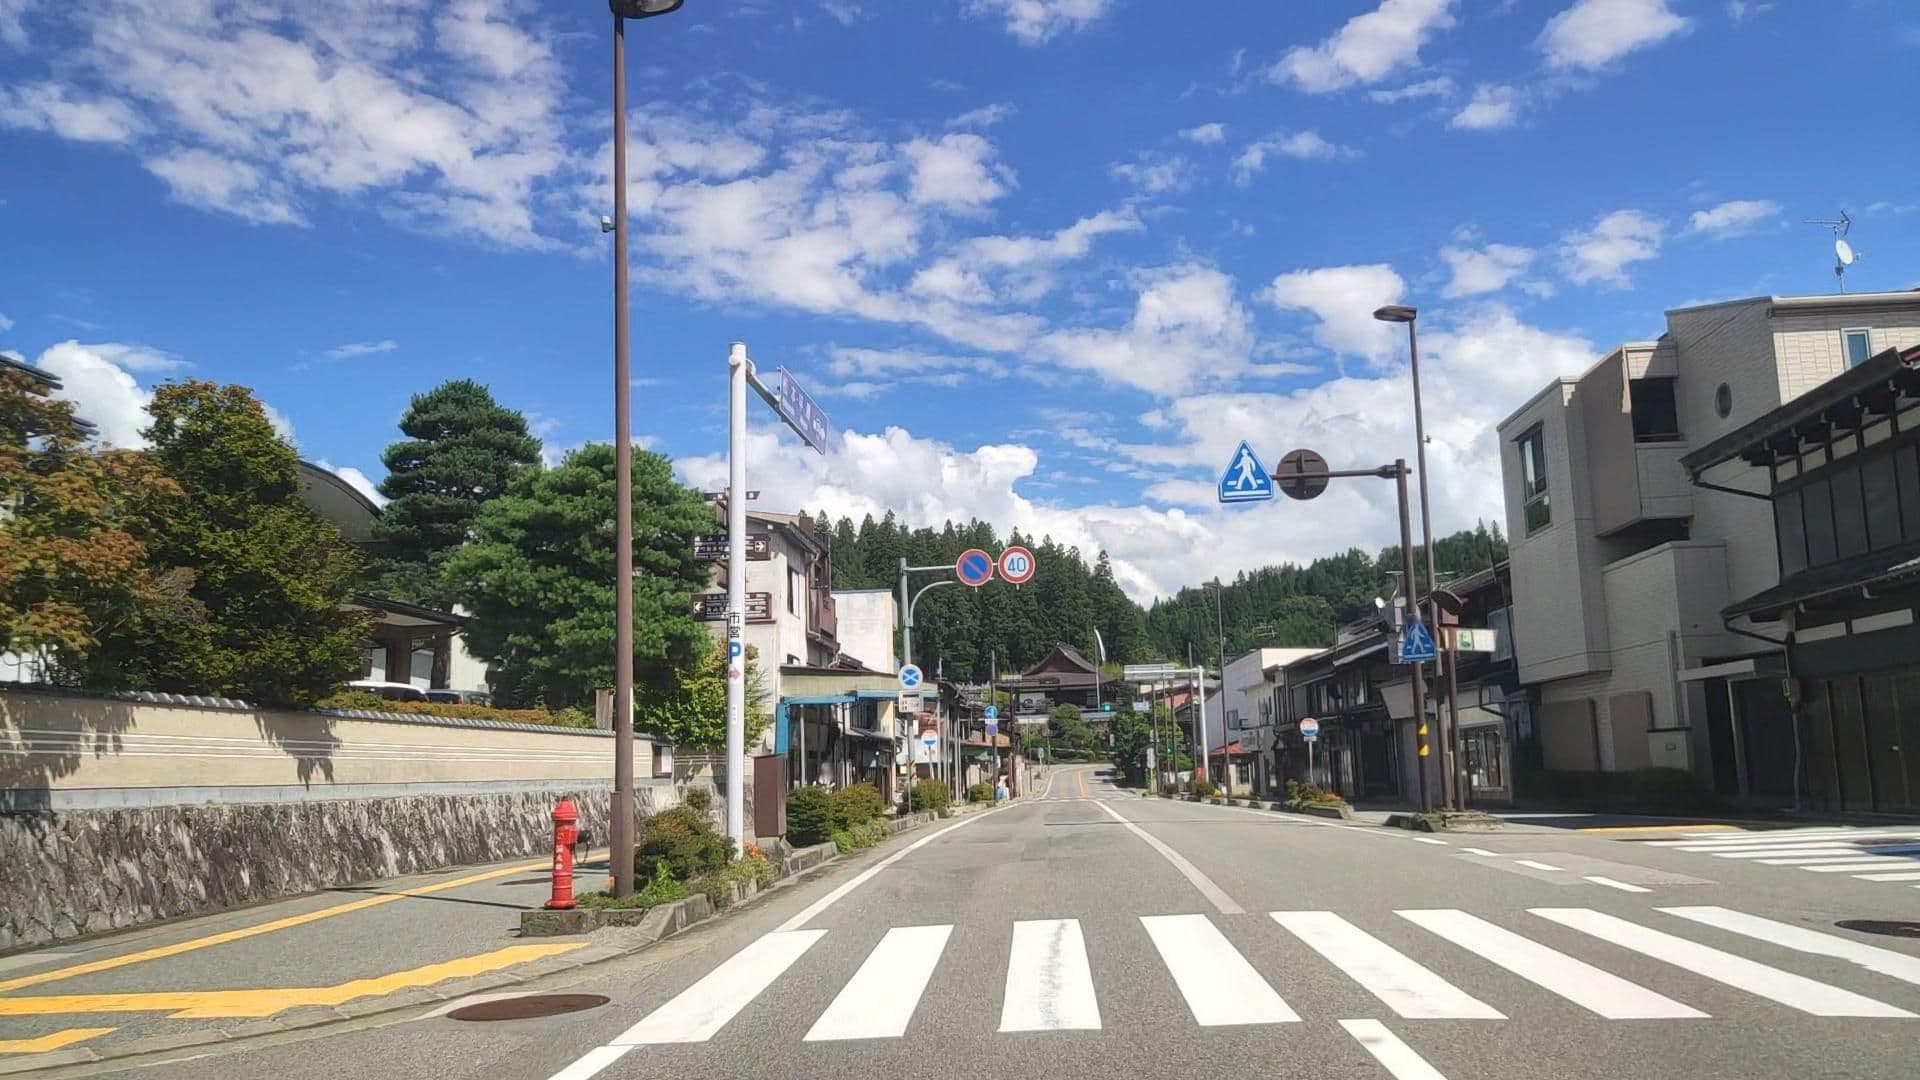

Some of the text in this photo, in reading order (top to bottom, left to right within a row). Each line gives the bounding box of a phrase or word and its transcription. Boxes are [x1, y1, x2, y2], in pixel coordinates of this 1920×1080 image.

[1007, 557, 1026, 572] 40
[729, 611, 741, 638] 市営
[728, 641, 741, 664] P
